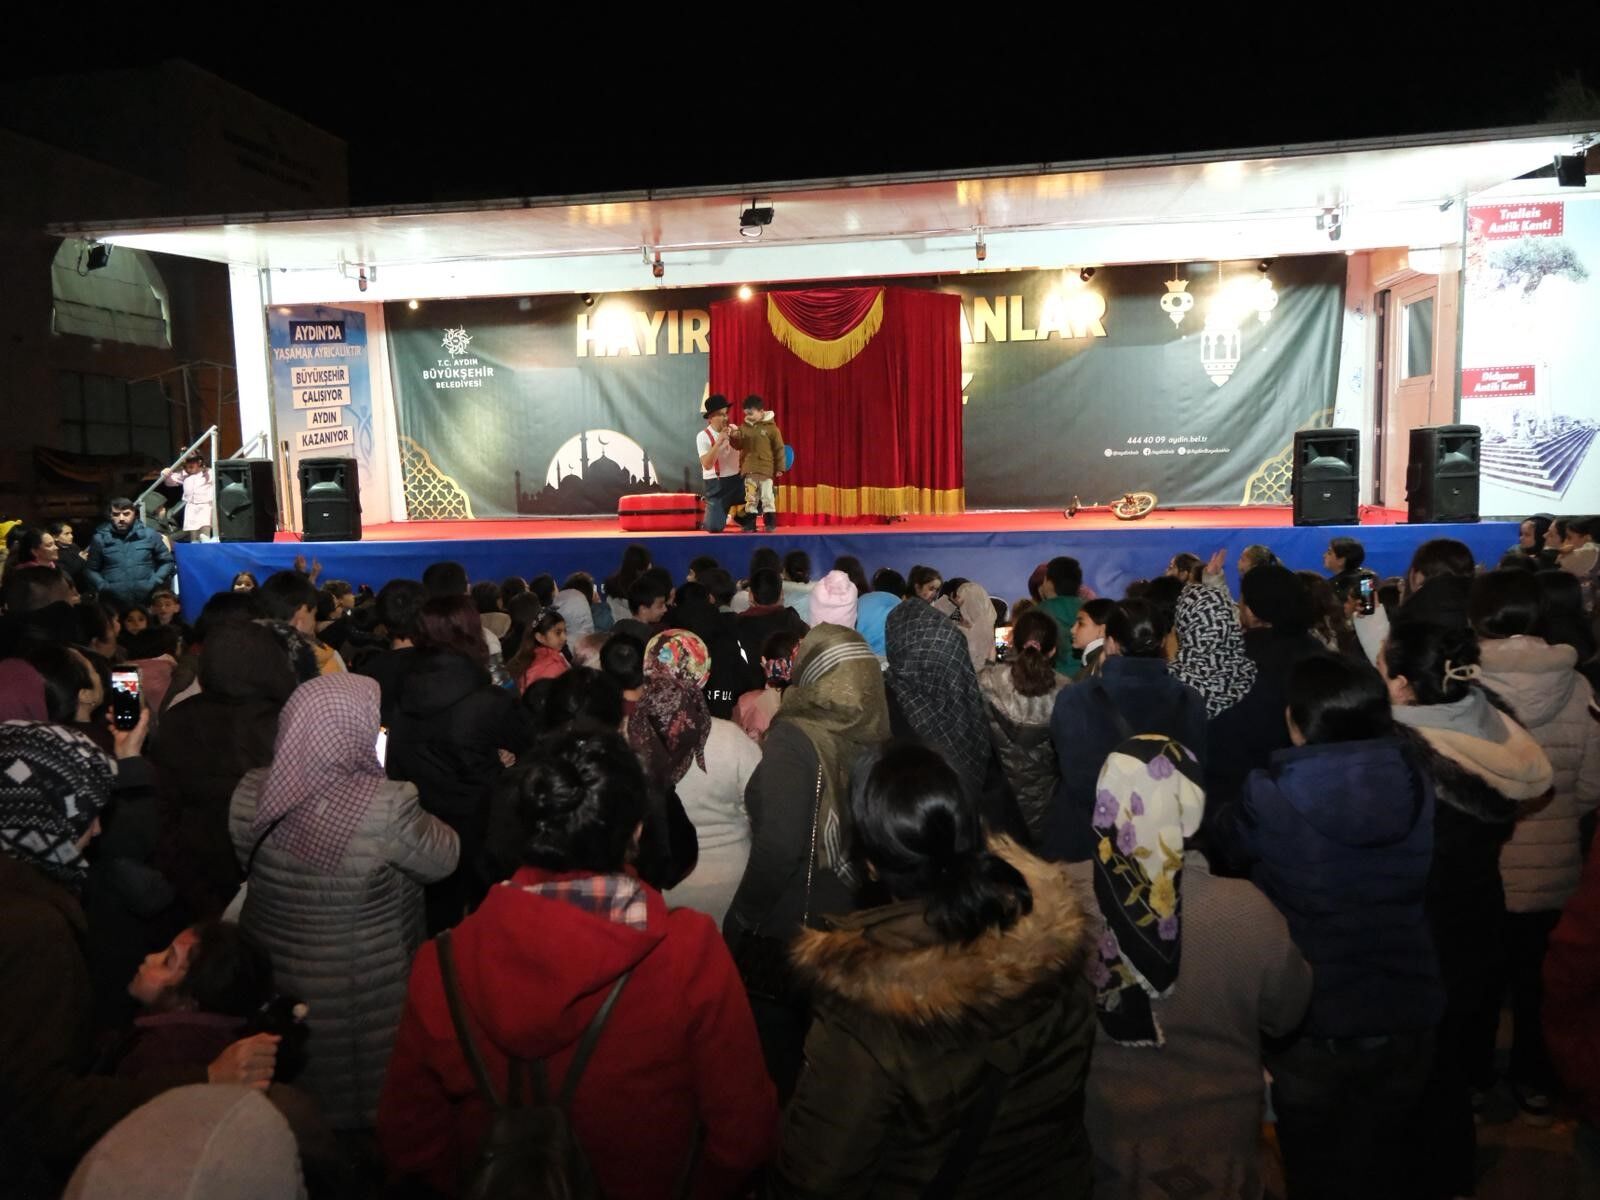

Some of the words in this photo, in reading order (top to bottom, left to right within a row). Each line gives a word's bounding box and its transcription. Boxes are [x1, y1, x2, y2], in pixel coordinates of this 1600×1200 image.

[1488, 221, 1520, 233] Antik
[1521, 219, 1552, 231] Kenti
[273, 347, 313, 361] YAŞAMAK
[453, 358, 479, 366] AYDIN
[296, 367, 345, 385] BÜYÜKŞEHİR
[423, 366, 494, 379] BÜYÜKŞEHİR
[436, 379, 482, 388] BELEDİYESİ
[302, 389, 343, 406] ÇALIŞIYOR
[312, 411, 337, 424] AYDIN
[302, 430, 349, 446] KAZANIYOR
[1127, 436, 1142, 444] 444
[1143, 436, 1154, 444] 40
[1155, 435, 1166, 444] 09
